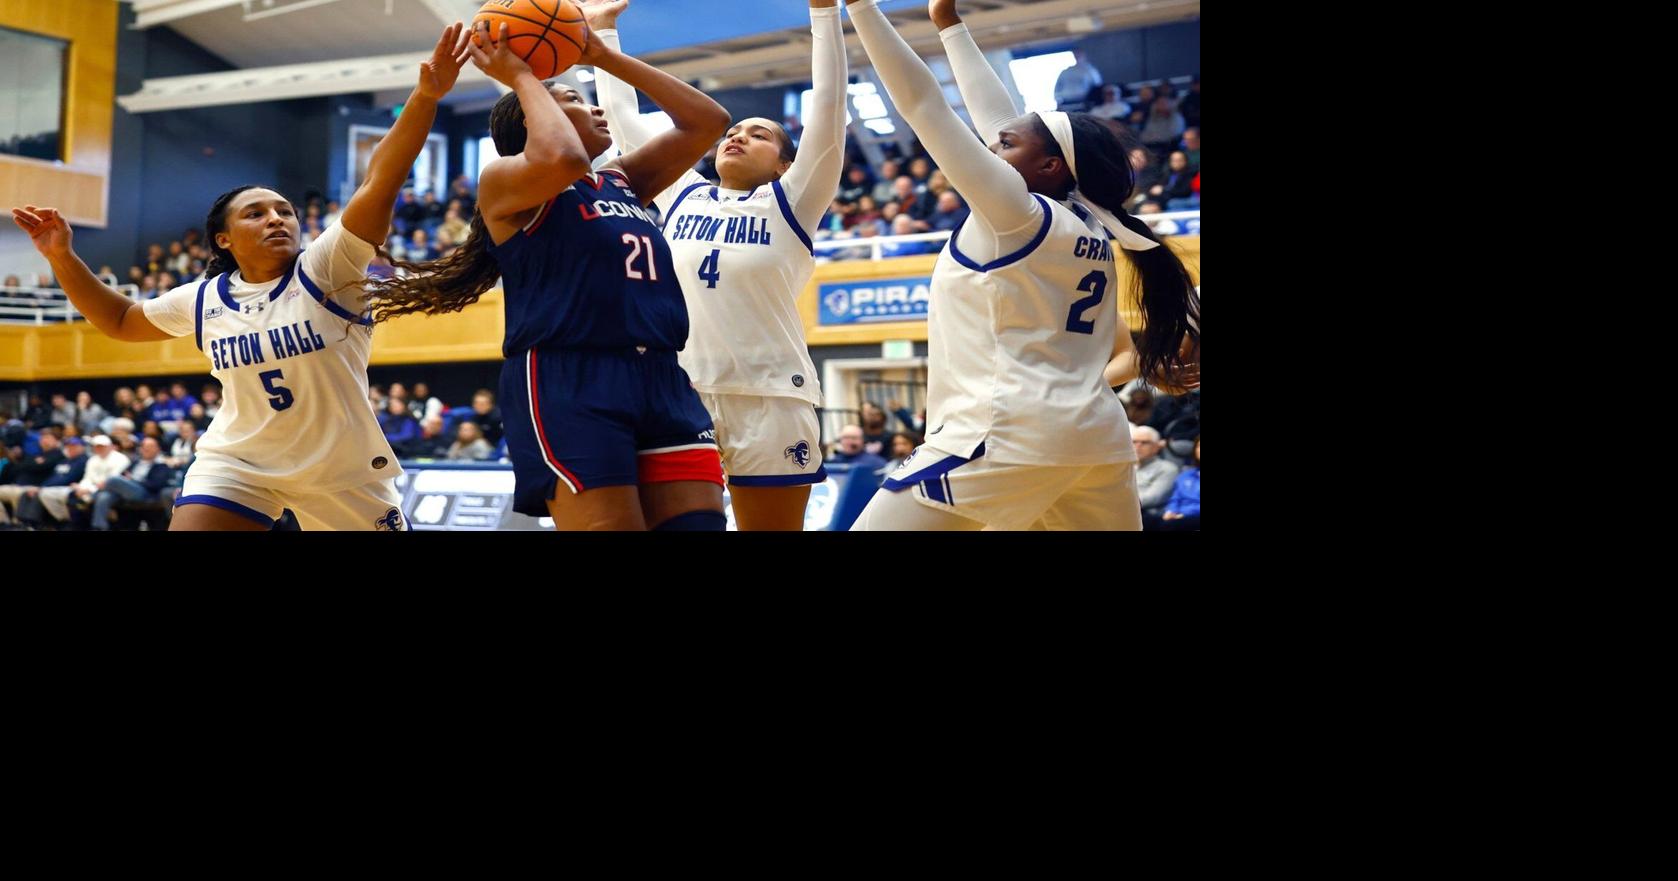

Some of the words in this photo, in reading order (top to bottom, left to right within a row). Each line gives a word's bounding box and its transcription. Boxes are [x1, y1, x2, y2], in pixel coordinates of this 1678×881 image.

[672, 214, 725, 241] SETON
[723, 216, 771, 246] HALL
[1073, 235, 1114, 262] CRA
[621, 232, 657, 281] 21
[697, 249, 720, 289] 4
[1065, 270, 1107, 334] 2
[210, 332, 265, 371] SETON
[267, 320, 326, 360] HALL
[258, 368, 294, 412] 5
